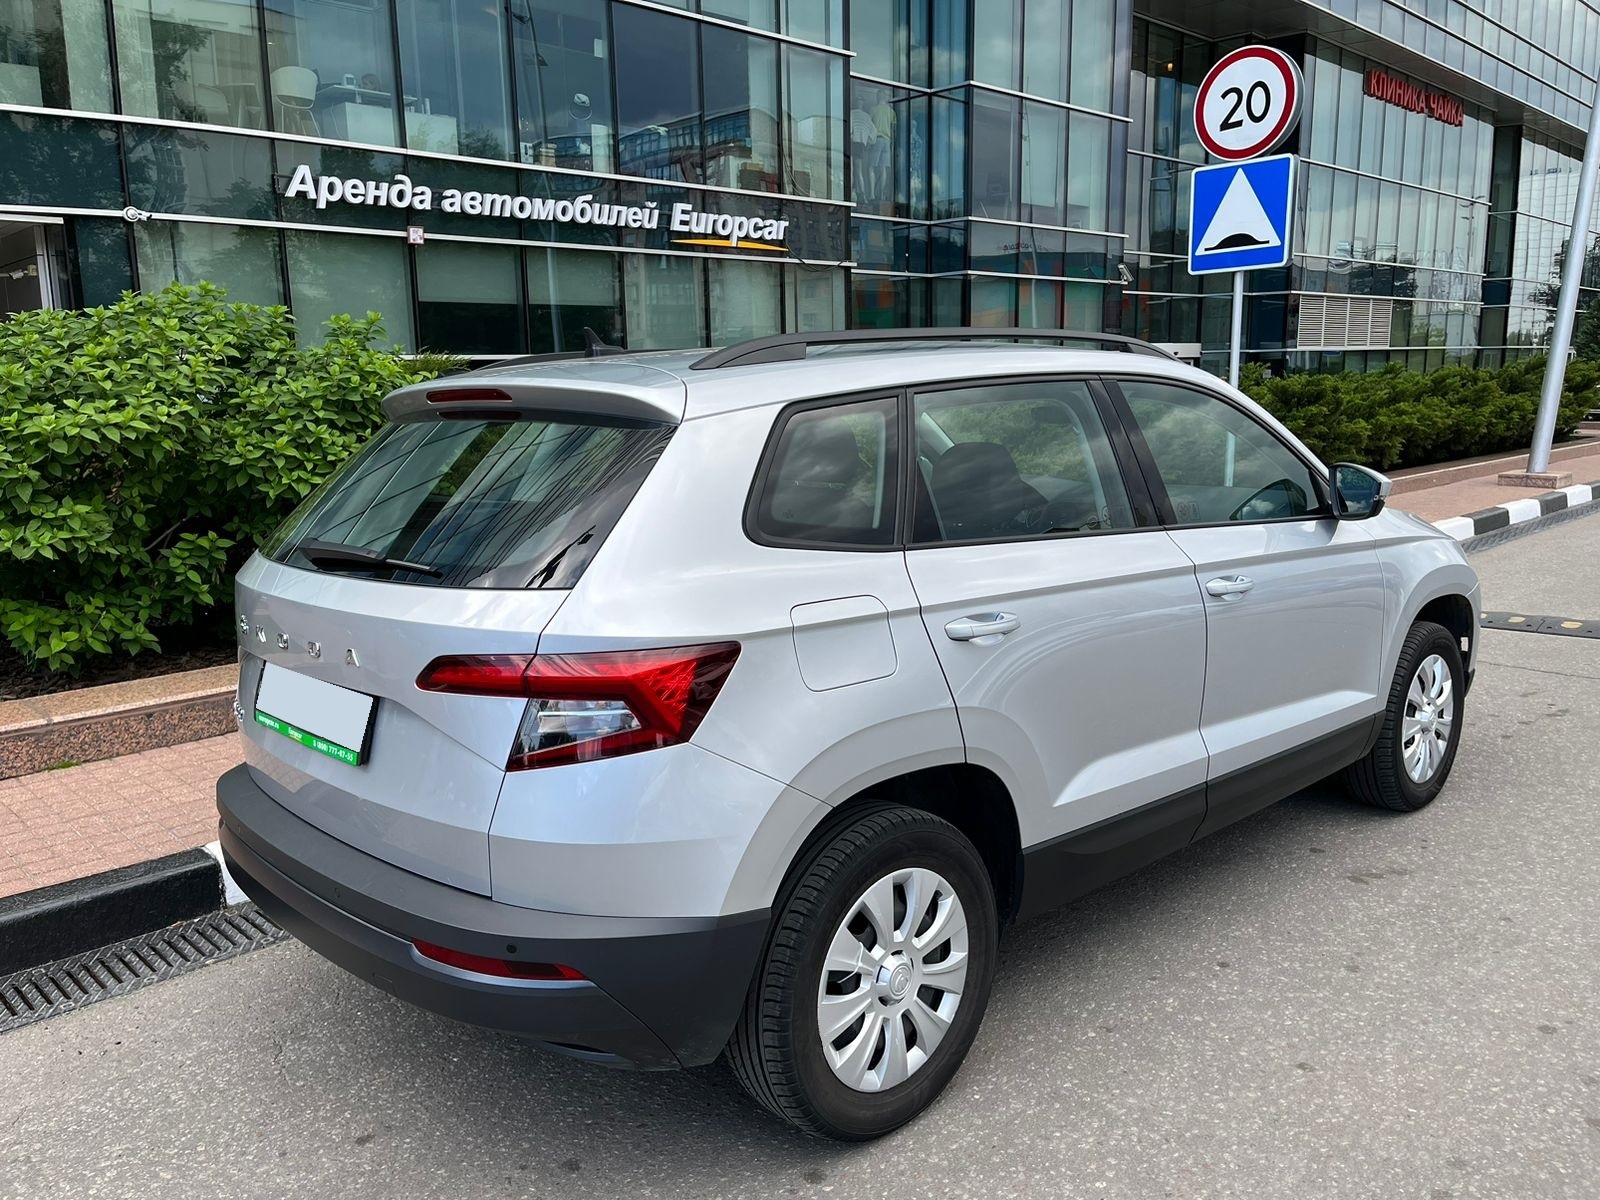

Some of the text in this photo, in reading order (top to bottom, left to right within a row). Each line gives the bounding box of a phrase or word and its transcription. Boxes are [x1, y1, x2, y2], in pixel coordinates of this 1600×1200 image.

[1219, 80, 1271, 132] 20
[1367, 69, 1465, 127] КЛИНИКА ЧАЙКА
[285, 165, 788, 245] Аренда автомобилей Europcar
